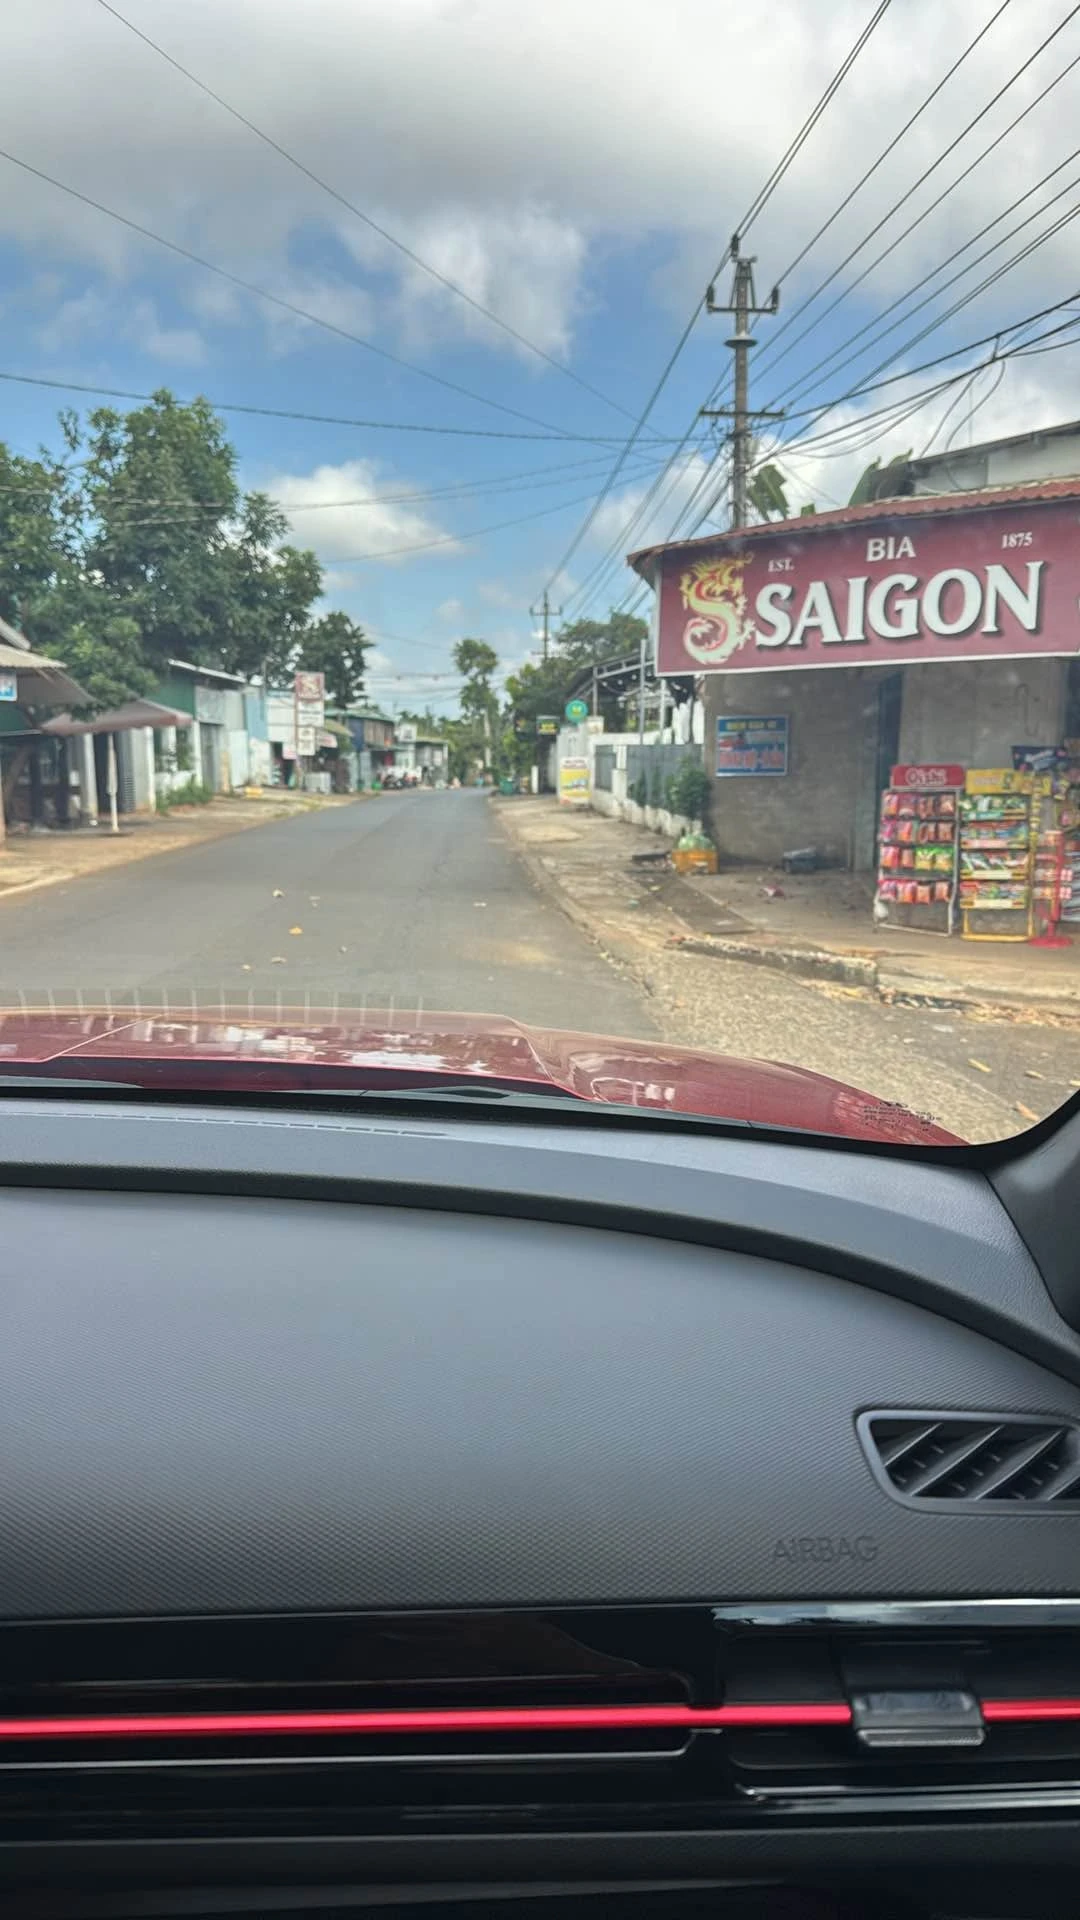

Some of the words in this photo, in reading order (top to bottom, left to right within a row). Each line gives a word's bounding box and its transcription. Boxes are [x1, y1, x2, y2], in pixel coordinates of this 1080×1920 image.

[865, 536, 916, 562] BIA
[1001, 532, 1033, 549] 1875
[755, 560, 1044, 648] SAIGON
[772, 1535, 879, 1563] AIRBAG
